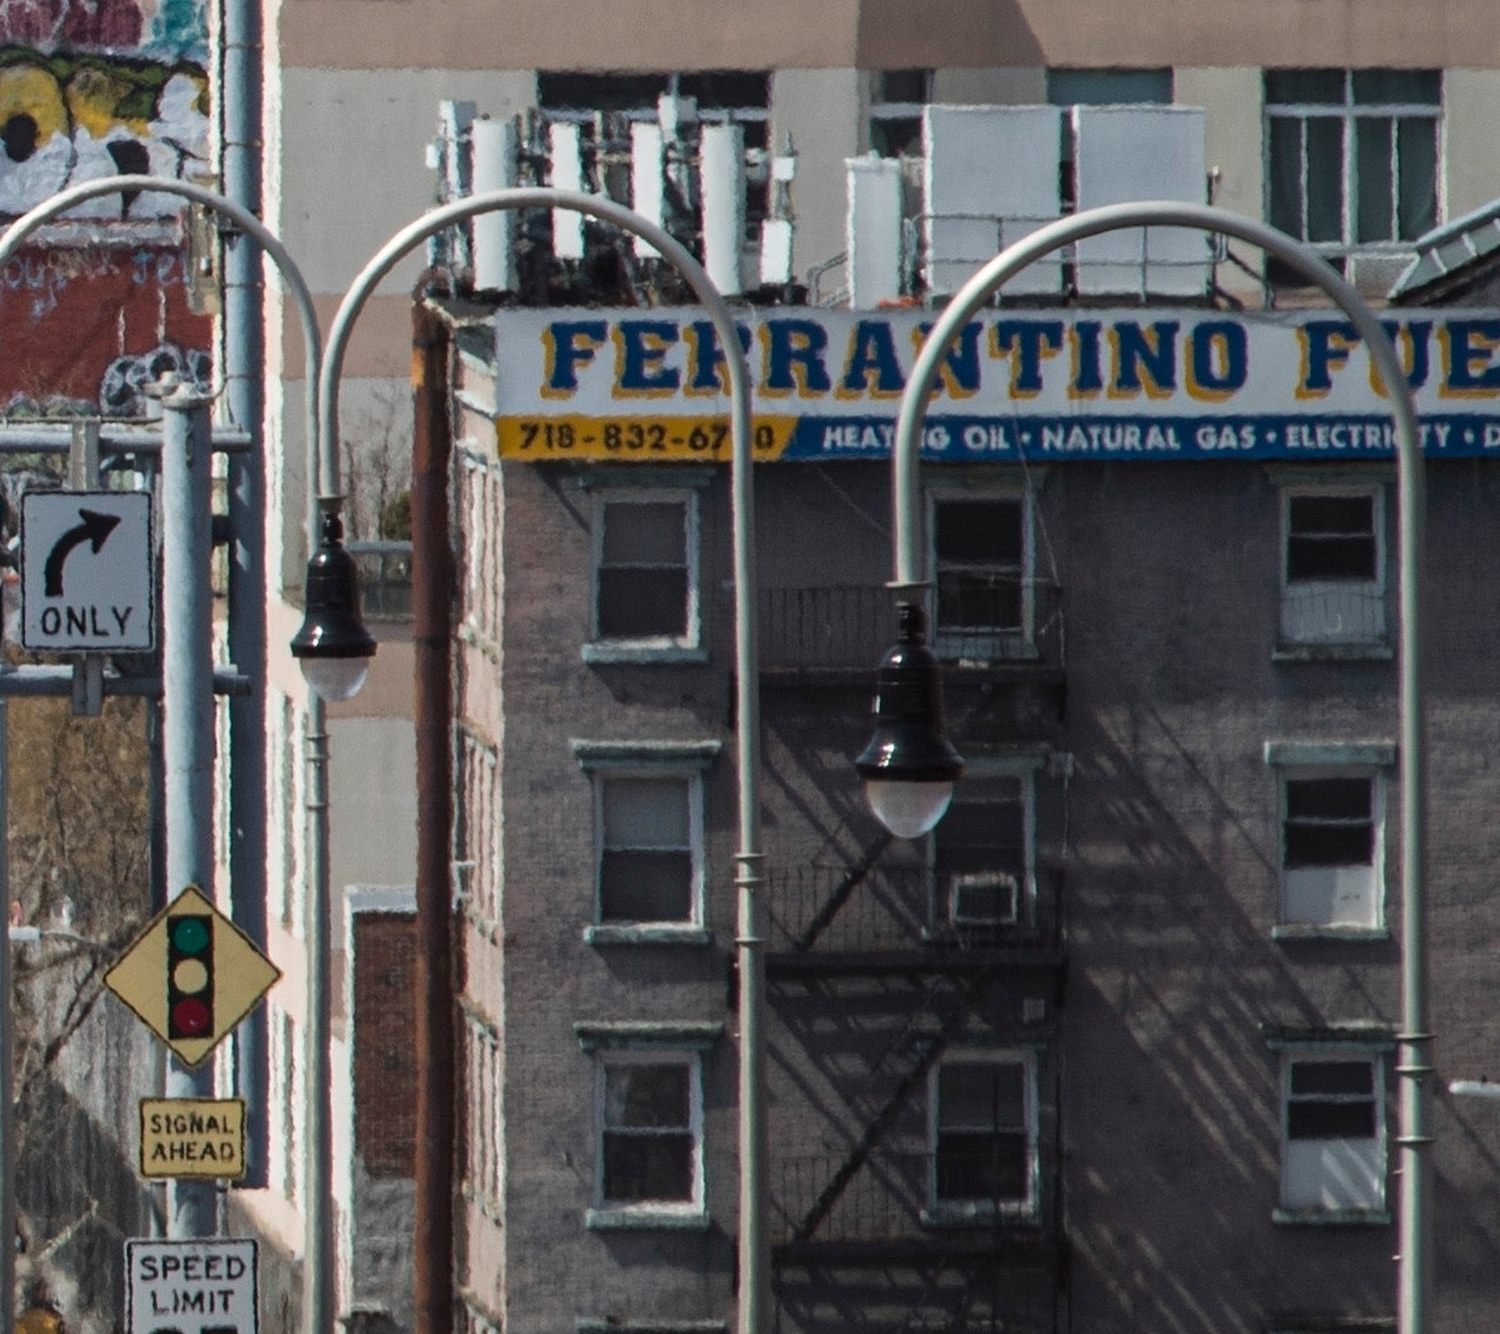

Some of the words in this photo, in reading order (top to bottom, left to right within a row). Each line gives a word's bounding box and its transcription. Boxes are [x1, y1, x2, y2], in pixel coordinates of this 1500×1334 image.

[540, 320, 1248, 402] FERRANTINO
[520, 423, 774, 452] 718-832-670
[964, 425, 1009, 450] OIL
[1042, 424, 1181, 451] NATURAL
[1196, 424, 1256, 451] GAS
[41, 606, 133, 637] ONLY
[151, 1113, 234, 1135] SIGNAL
[152, 1141, 235, 1162] AHEAD
[141, 1255, 246, 1281] SPEED
[151, 1289, 235, 1314] LIMIT
